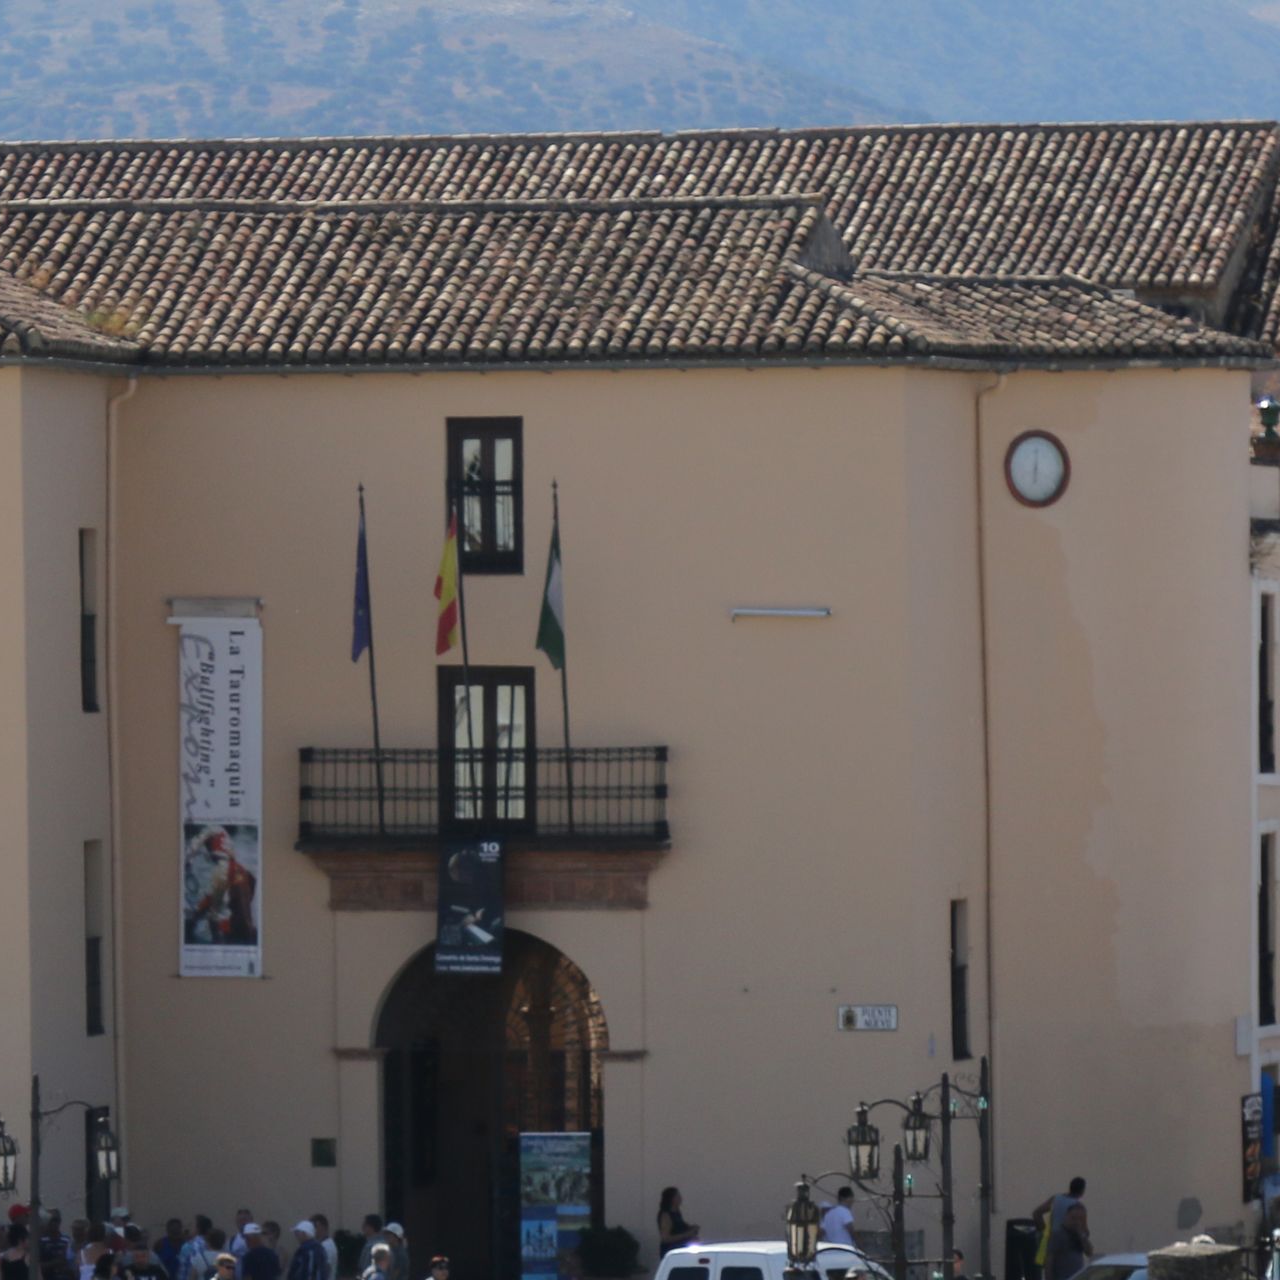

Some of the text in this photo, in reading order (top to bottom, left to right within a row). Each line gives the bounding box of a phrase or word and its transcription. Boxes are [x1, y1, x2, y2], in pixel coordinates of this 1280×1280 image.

[225, 630, 245, 808] La Tauromaquia
[480, 842, 500, 853] 10
